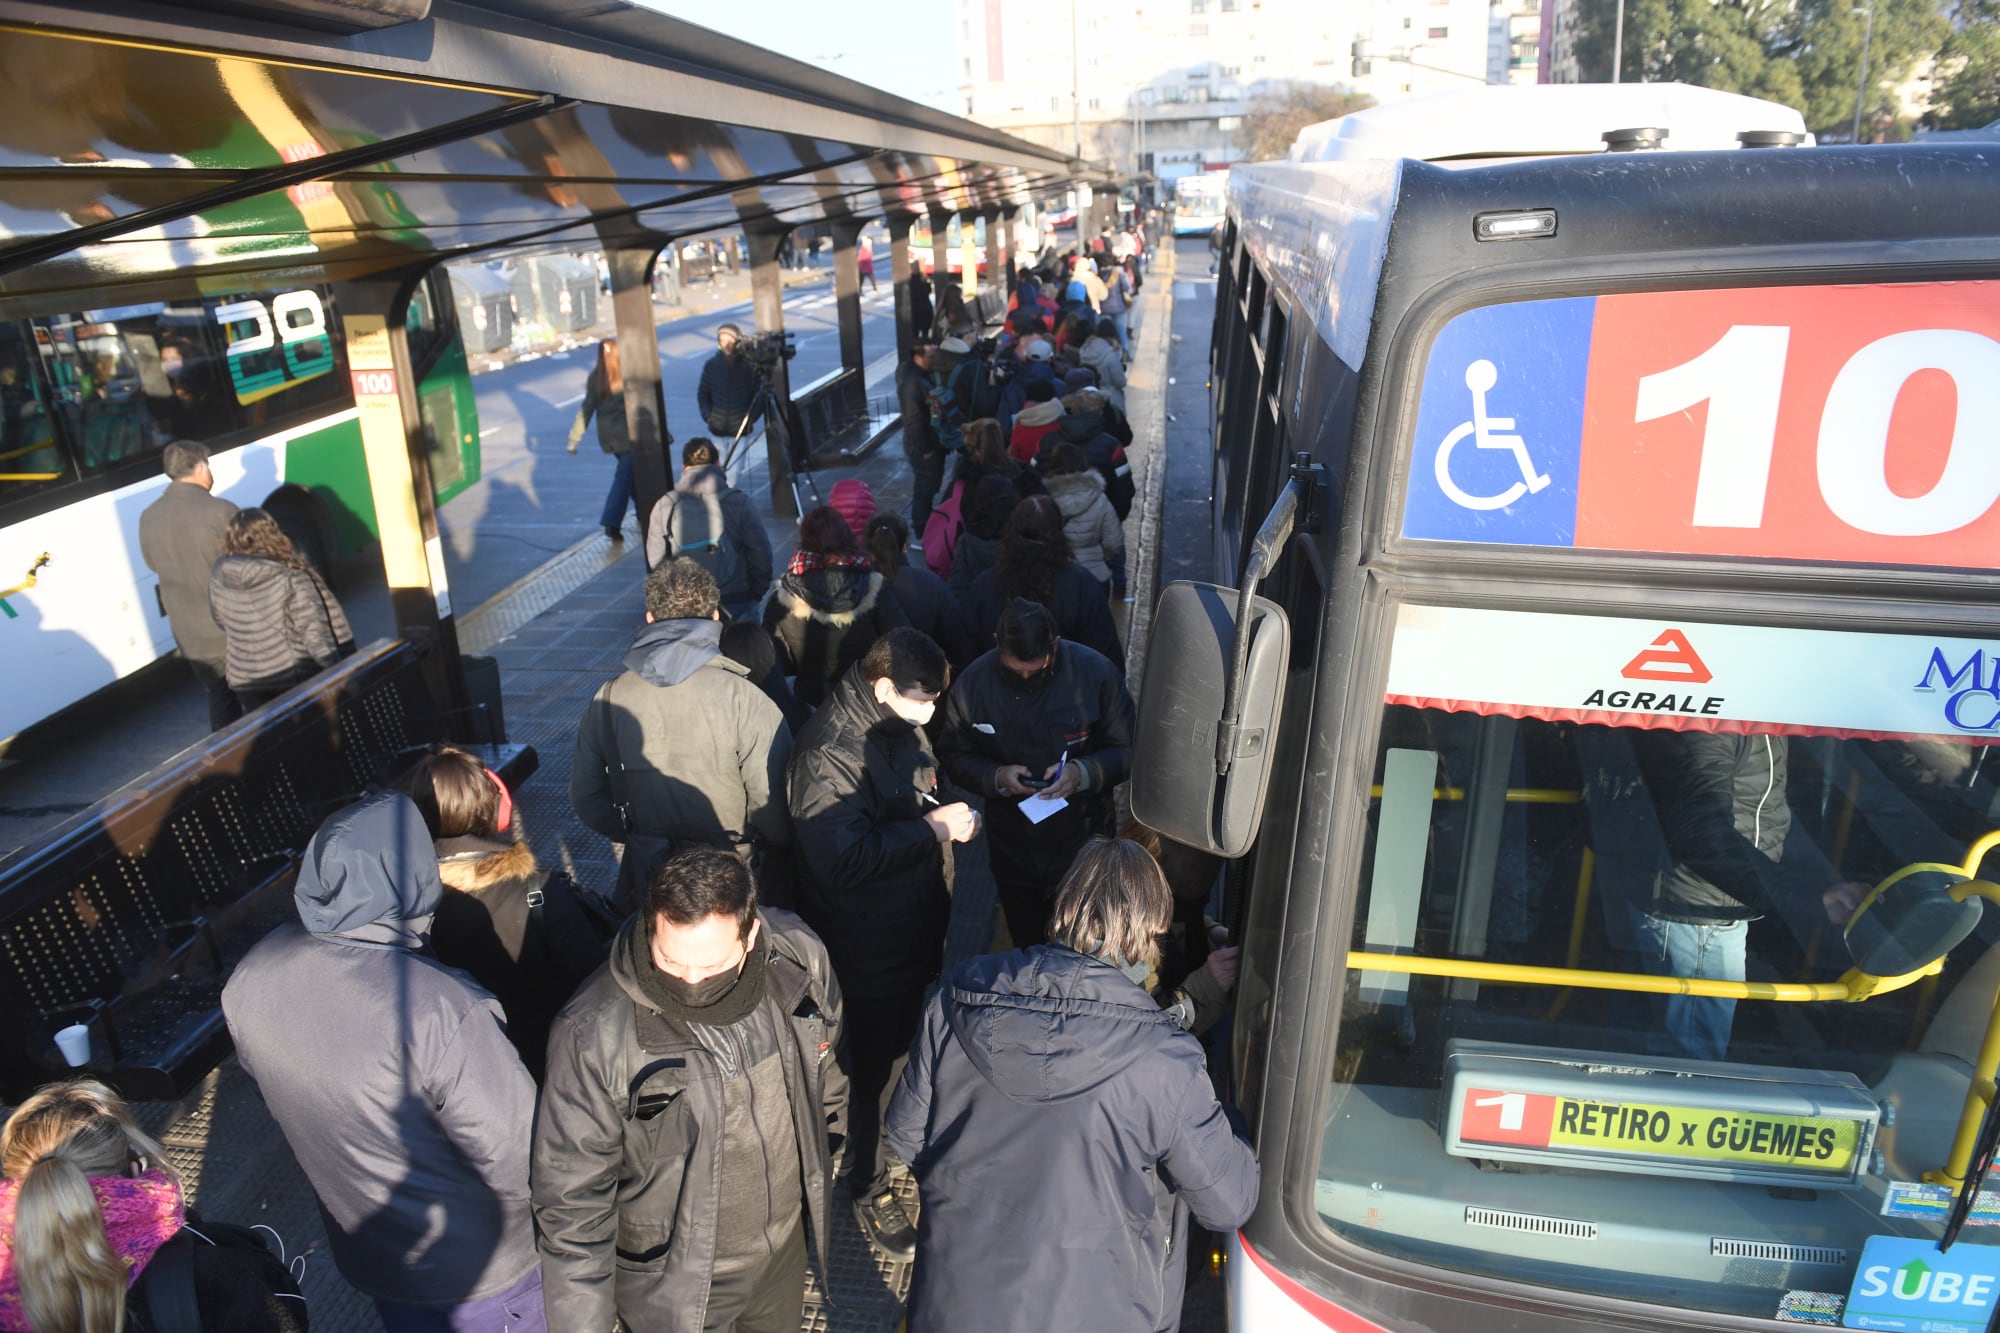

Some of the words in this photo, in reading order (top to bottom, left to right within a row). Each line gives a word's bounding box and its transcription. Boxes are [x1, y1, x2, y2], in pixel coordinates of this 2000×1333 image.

[357, 373, 393, 394] 100
[1582, 689, 1725, 715] AGRALE
[1476, 1093, 1527, 1130] 1
[1558, 1101, 1671, 1143] RETIRO
[1679, 1123, 1699, 1147] x
[1706, 1115, 1837, 1161] GÜEMES
[1860, 1264, 1996, 1307] SUBE
